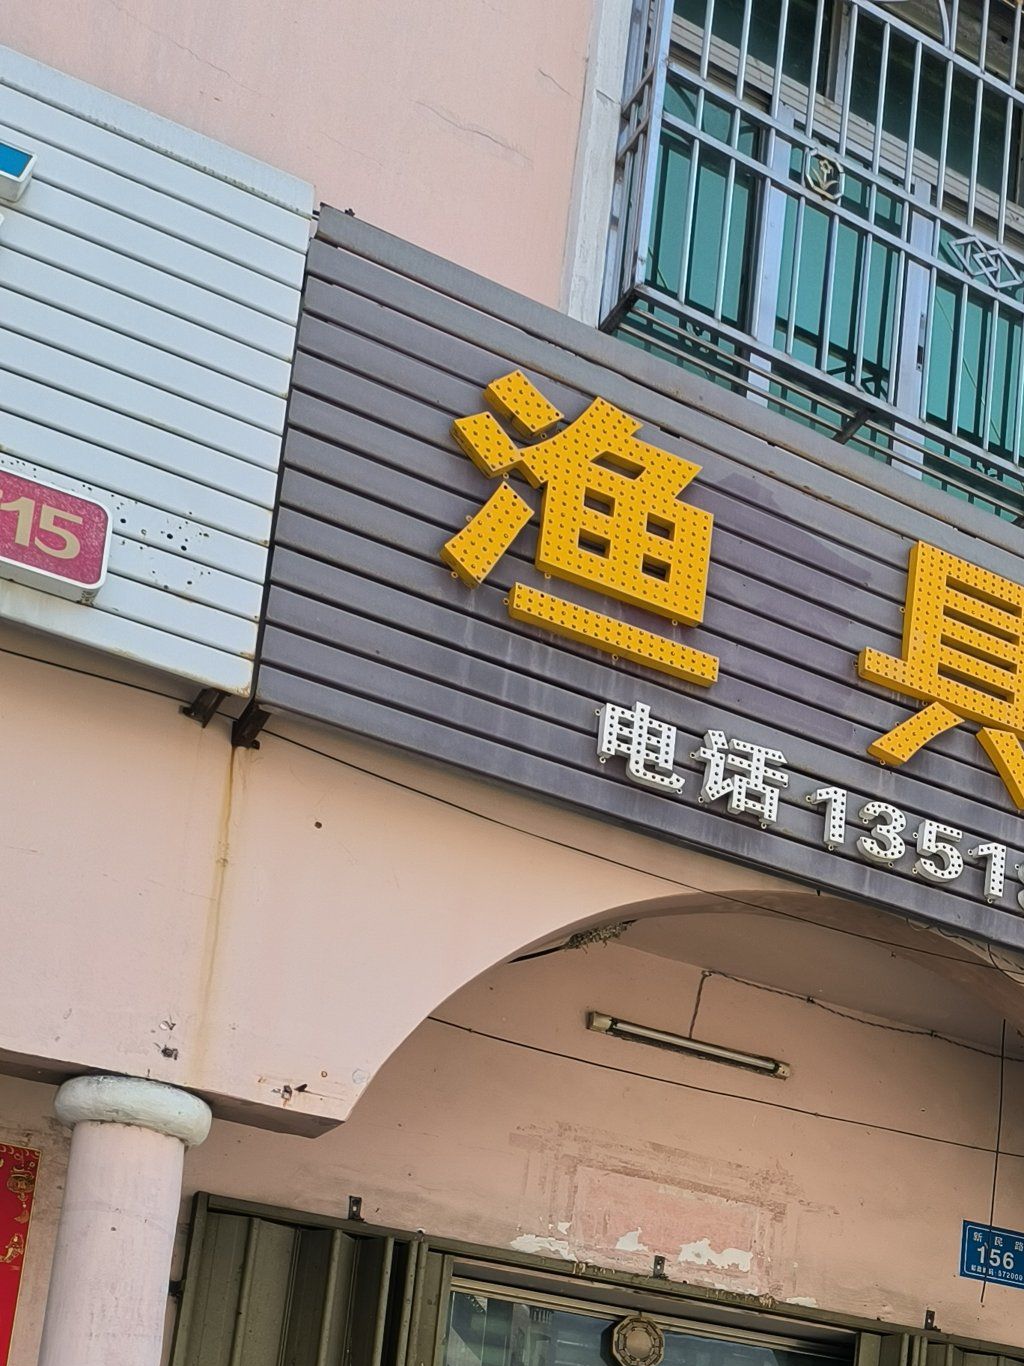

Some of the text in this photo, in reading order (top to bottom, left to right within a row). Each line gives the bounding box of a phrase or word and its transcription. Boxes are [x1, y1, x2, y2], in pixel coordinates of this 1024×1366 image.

[0, 489, 83, 560] 15
[597, 701, 790, 826] 电话
[977, 1245, 1014, 1270] 156
